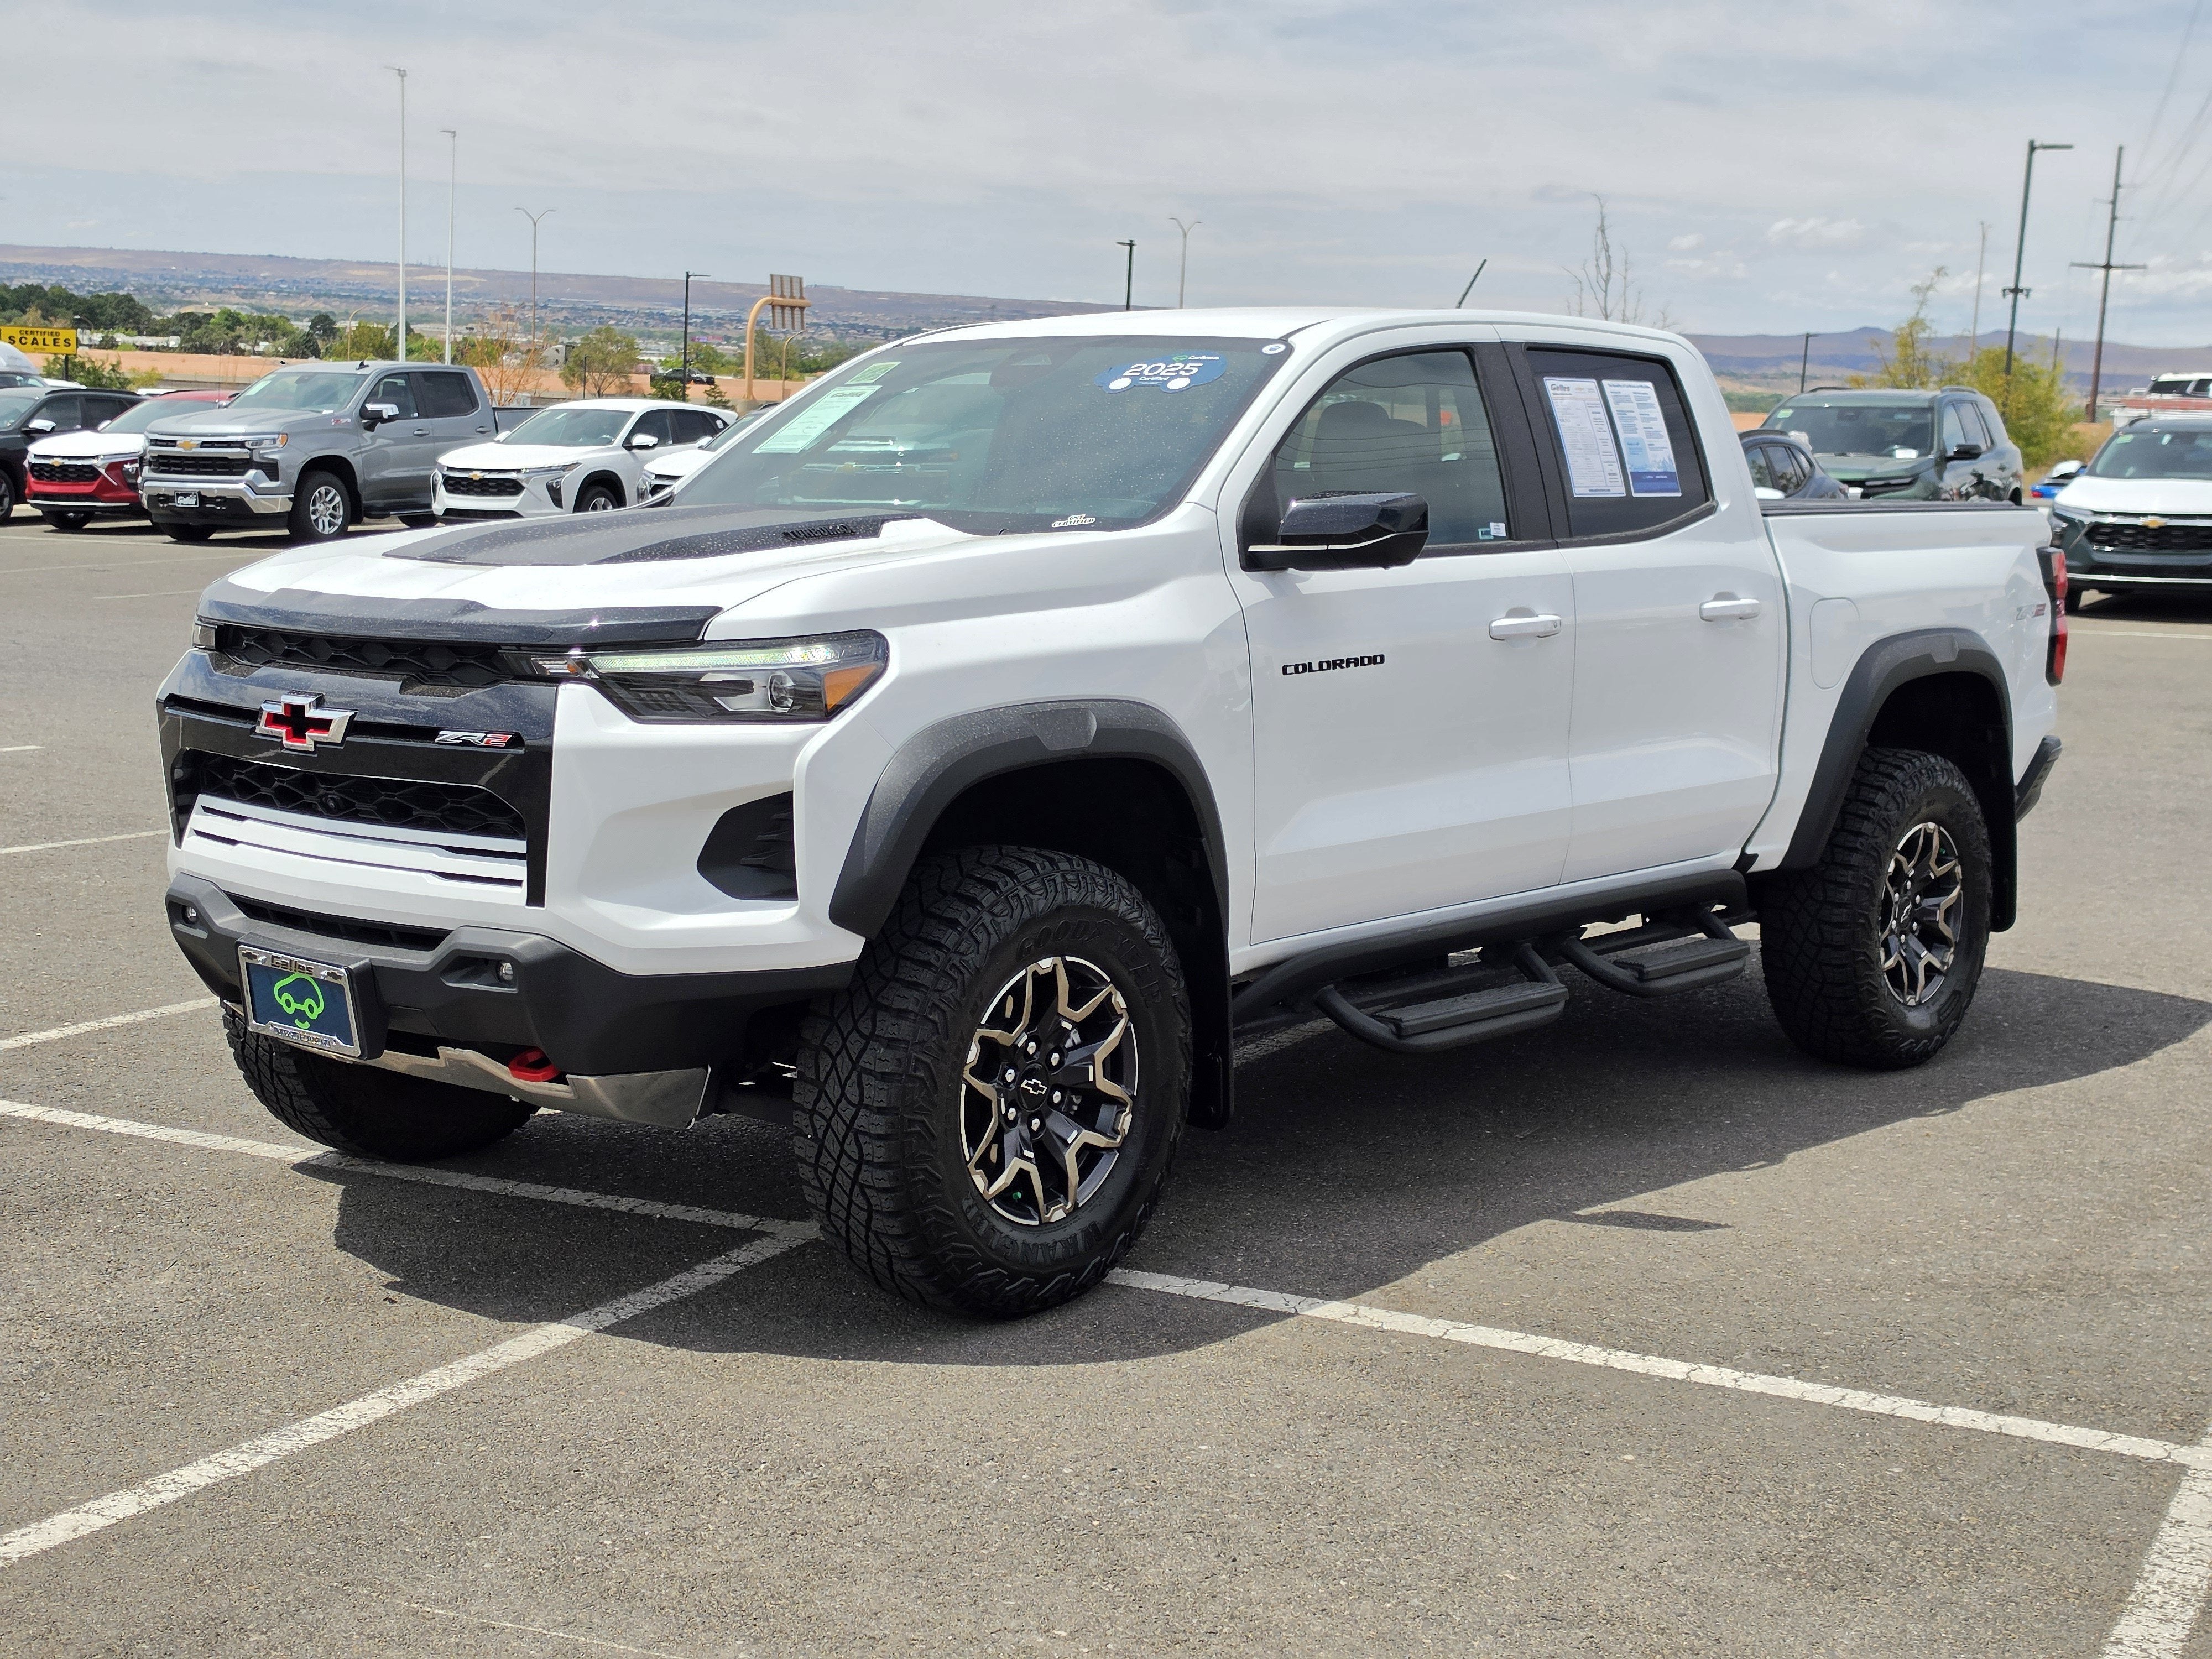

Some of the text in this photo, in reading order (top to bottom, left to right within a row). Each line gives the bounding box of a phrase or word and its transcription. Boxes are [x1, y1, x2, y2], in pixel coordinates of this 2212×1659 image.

[8, 335, 71, 347] SCALES
[1123, 363, 1204, 376] 2025
[2016, 603, 2047, 621] ZR2
[1282, 654, 1385, 676] COLORADO
[435, 731, 513, 747] ZR2
[270, 954, 315, 975] Galles
